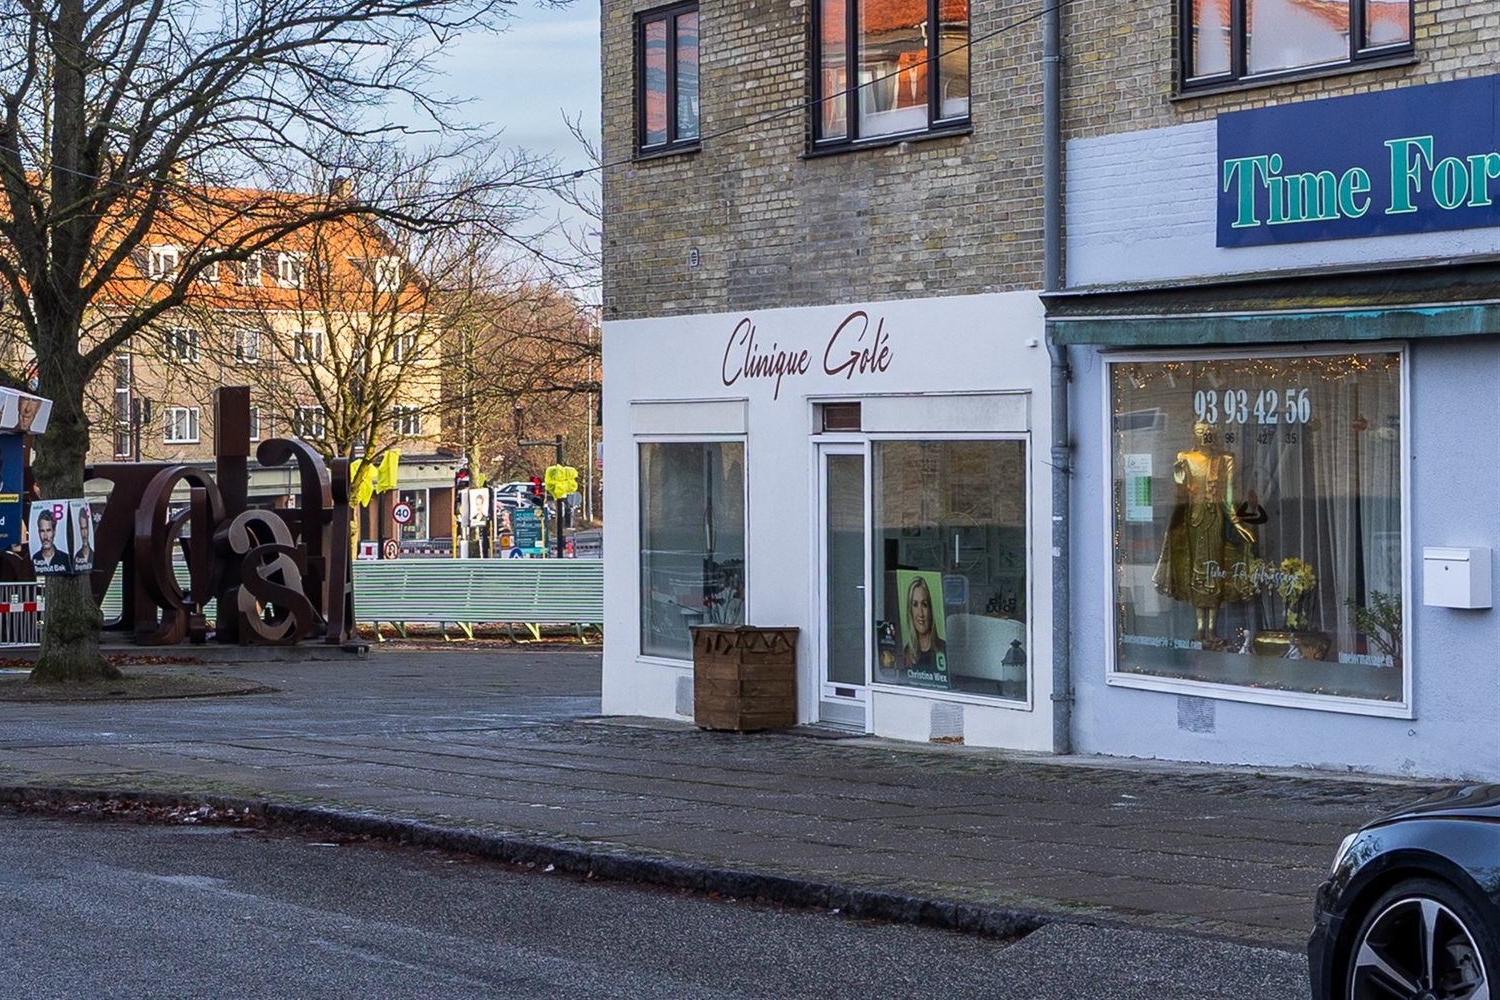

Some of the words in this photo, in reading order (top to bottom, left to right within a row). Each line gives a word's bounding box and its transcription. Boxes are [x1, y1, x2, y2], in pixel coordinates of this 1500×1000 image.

[1224, 153, 1371, 228] Time
[1384, 135, 1500, 214] For
[722, 317, 812, 400] Clinique
[823, 311, 893, 380] Golé
[1194, 389, 1218, 424] 93
[1224, 389, 1248, 424] 93
[1253, 389, 1278, 424] 42
[1285, 388, 1311, 424] 56
[52, 504, 64, 521] B
[395, 508, 409, 518] 40
